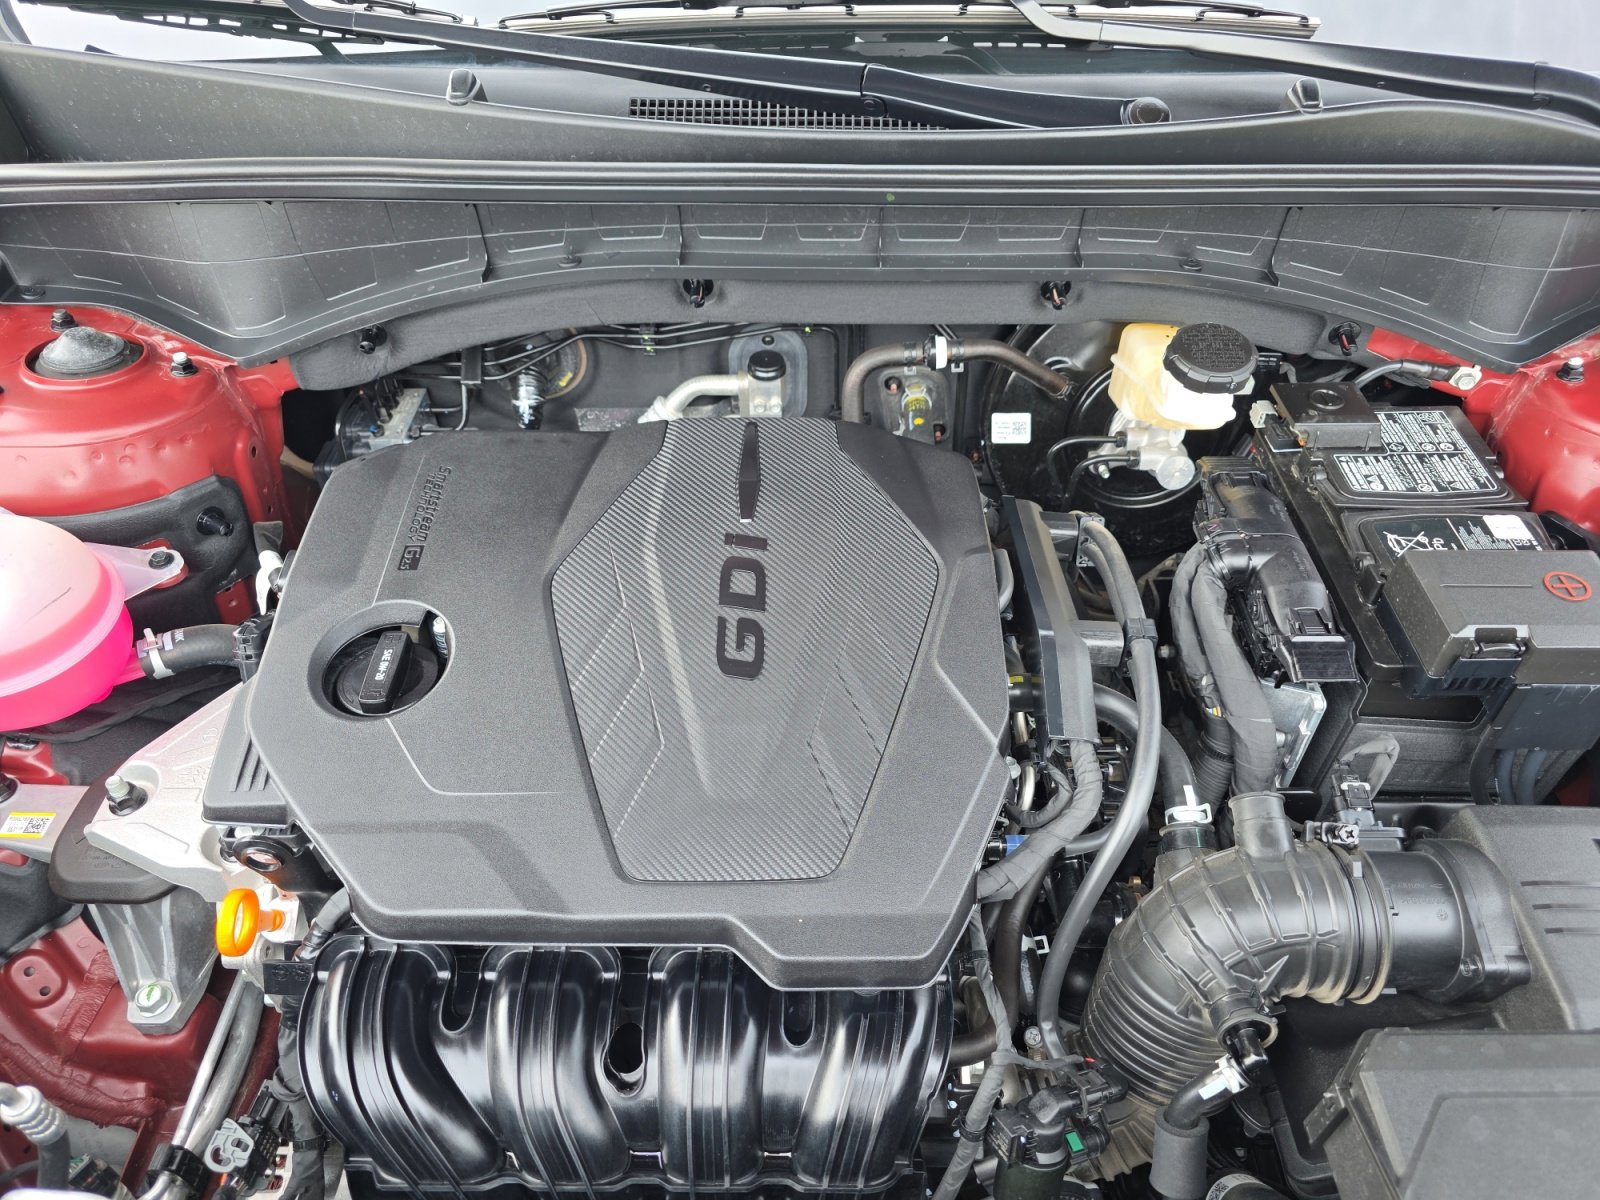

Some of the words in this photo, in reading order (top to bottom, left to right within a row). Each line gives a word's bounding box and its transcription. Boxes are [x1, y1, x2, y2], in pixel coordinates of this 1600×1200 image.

[408, 473, 437, 542] TECHNOLOGY
[417, 465, 452, 543] Smartstream
[381, 649, 393, 661] SAE
